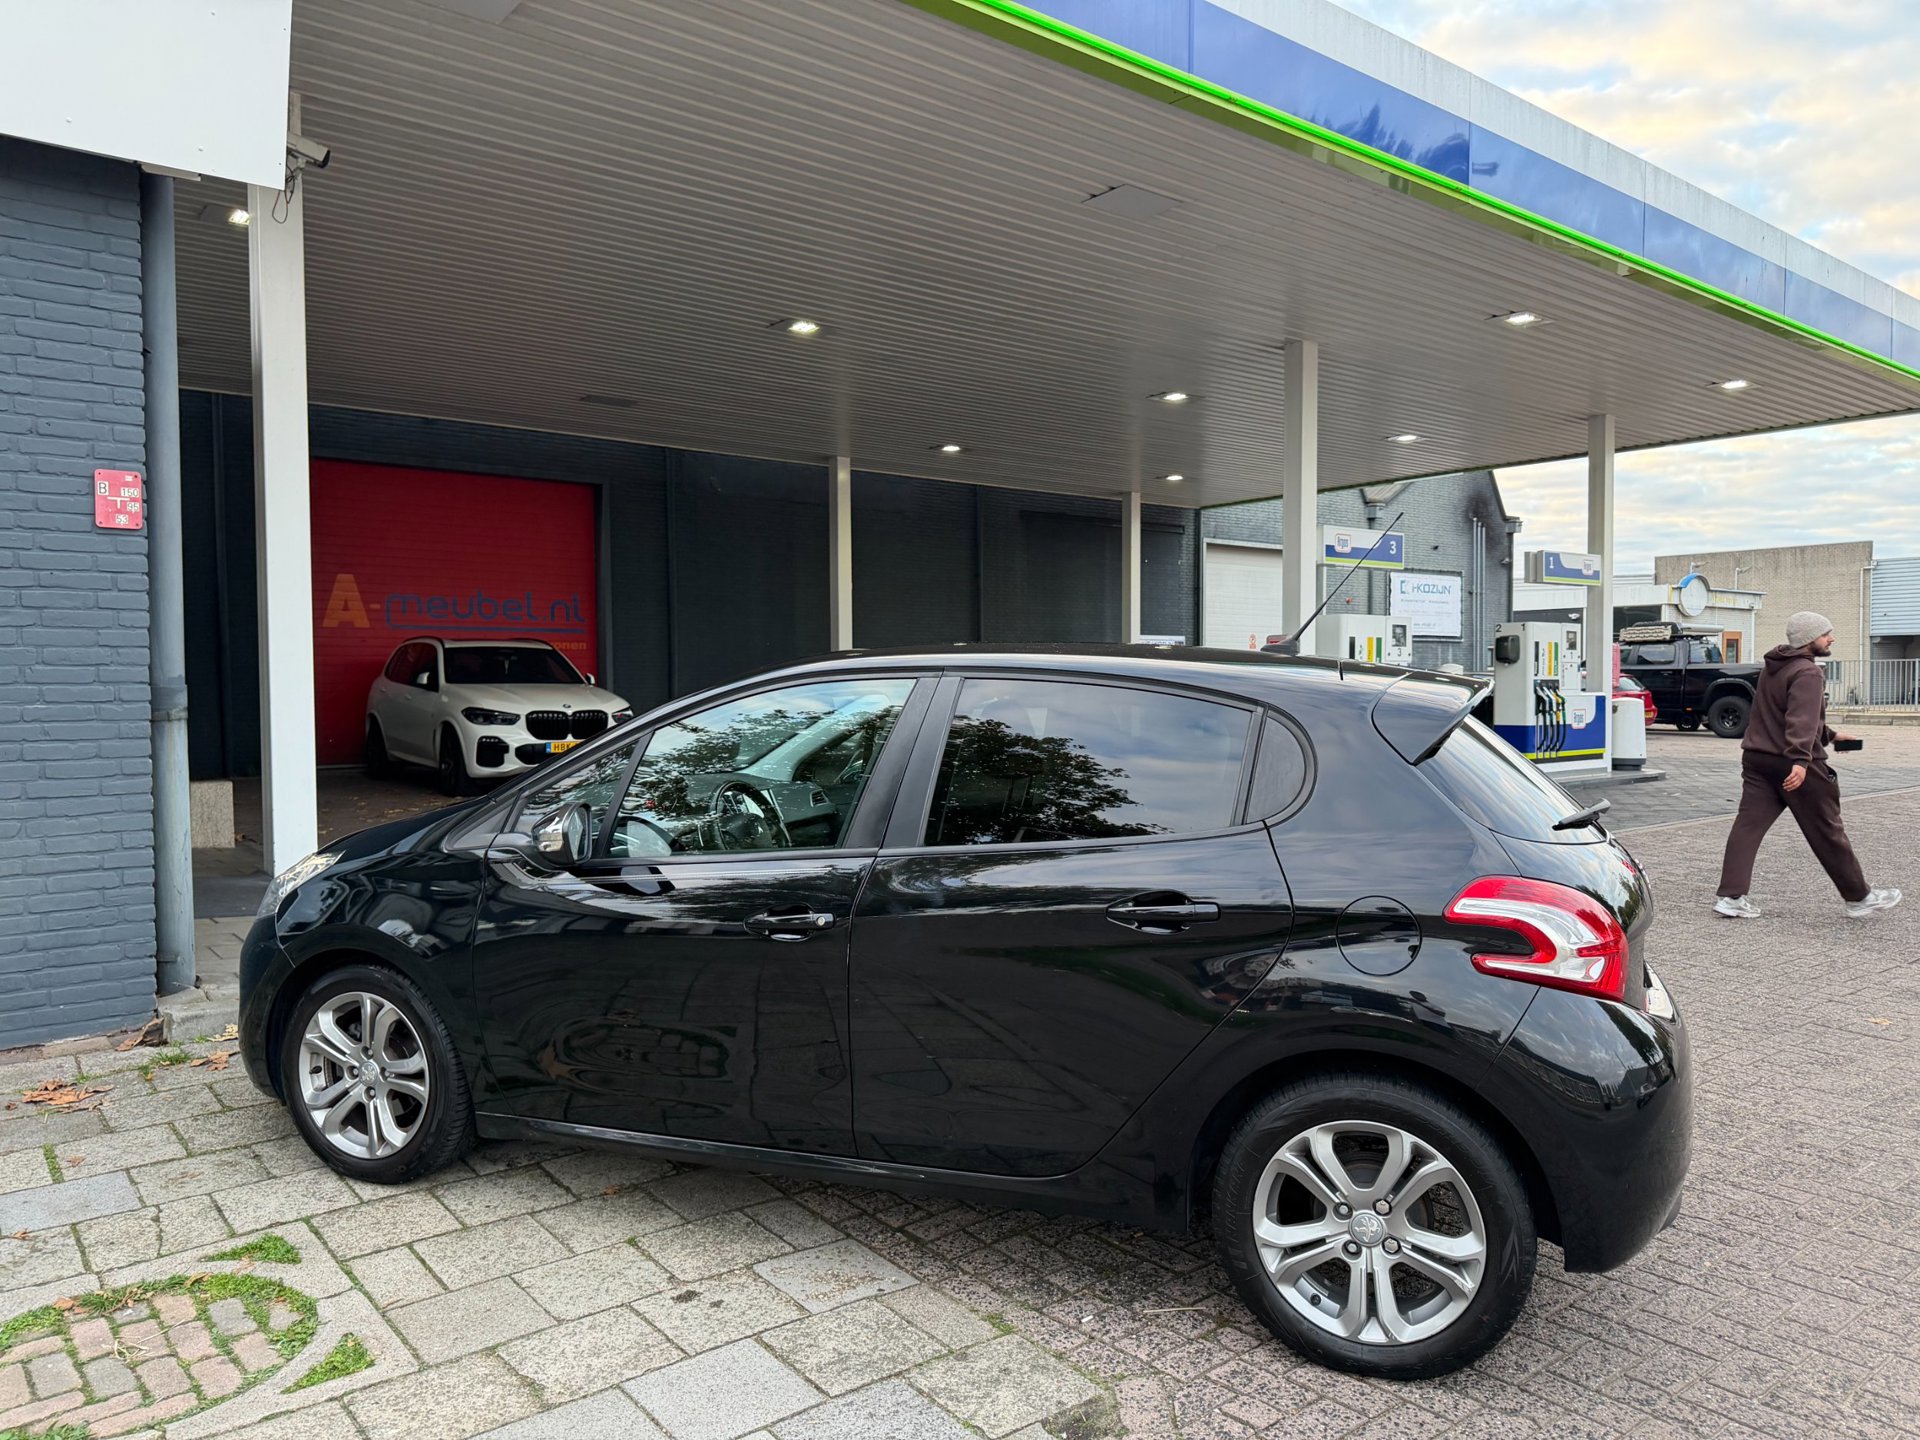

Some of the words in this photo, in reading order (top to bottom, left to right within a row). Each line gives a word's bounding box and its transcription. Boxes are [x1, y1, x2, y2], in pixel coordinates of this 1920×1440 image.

[98, 481, 108, 494] B
[122, 488, 139, 497] 150
[1389, 540, 1397, 554] 3
[1549, 556, 1554, 568] 1
[1496, 624, 1502, 632] 2
[1520, 623, 1526, 631] 1
[551, 641, 587, 650] onen
[1397, 648, 1402, 656] 3
